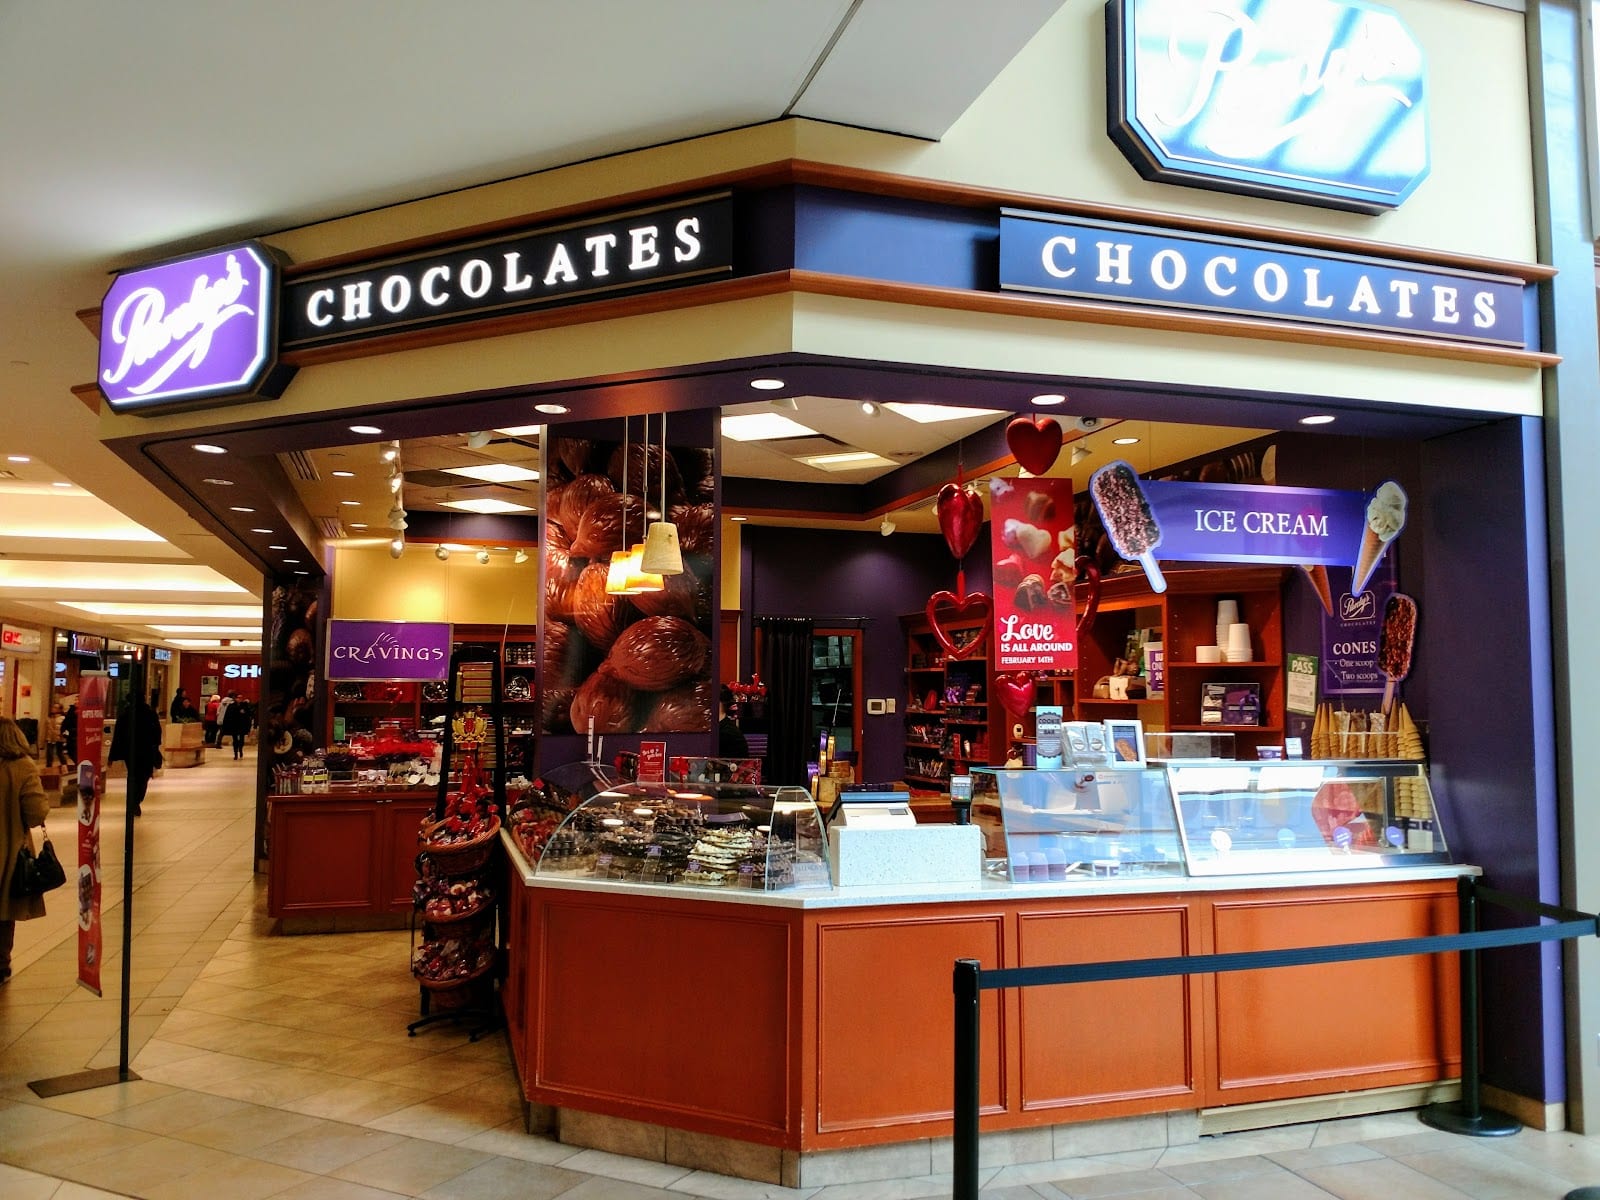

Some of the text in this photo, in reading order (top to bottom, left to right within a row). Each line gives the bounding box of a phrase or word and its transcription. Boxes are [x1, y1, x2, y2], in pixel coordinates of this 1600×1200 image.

[306, 216, 703, 328] CHOCOLATES
[1041, 235, 1497, 329] CHOCOLATES
[1194, 509, 1330, 537] ICE CREAM
[1000, 614, 1054, 642] Love
[333, 642, 445, 664] CRAVINGS
[1000, 643, 1073, 653] IS ALL AROUND
[1333, 640, 1377, 656] CONES
[1001, 656, 1054, 665] FEBRUARY 14TH
[1291, 661, 1314, 674] PASS
[223, 664, 262, 678] SH
